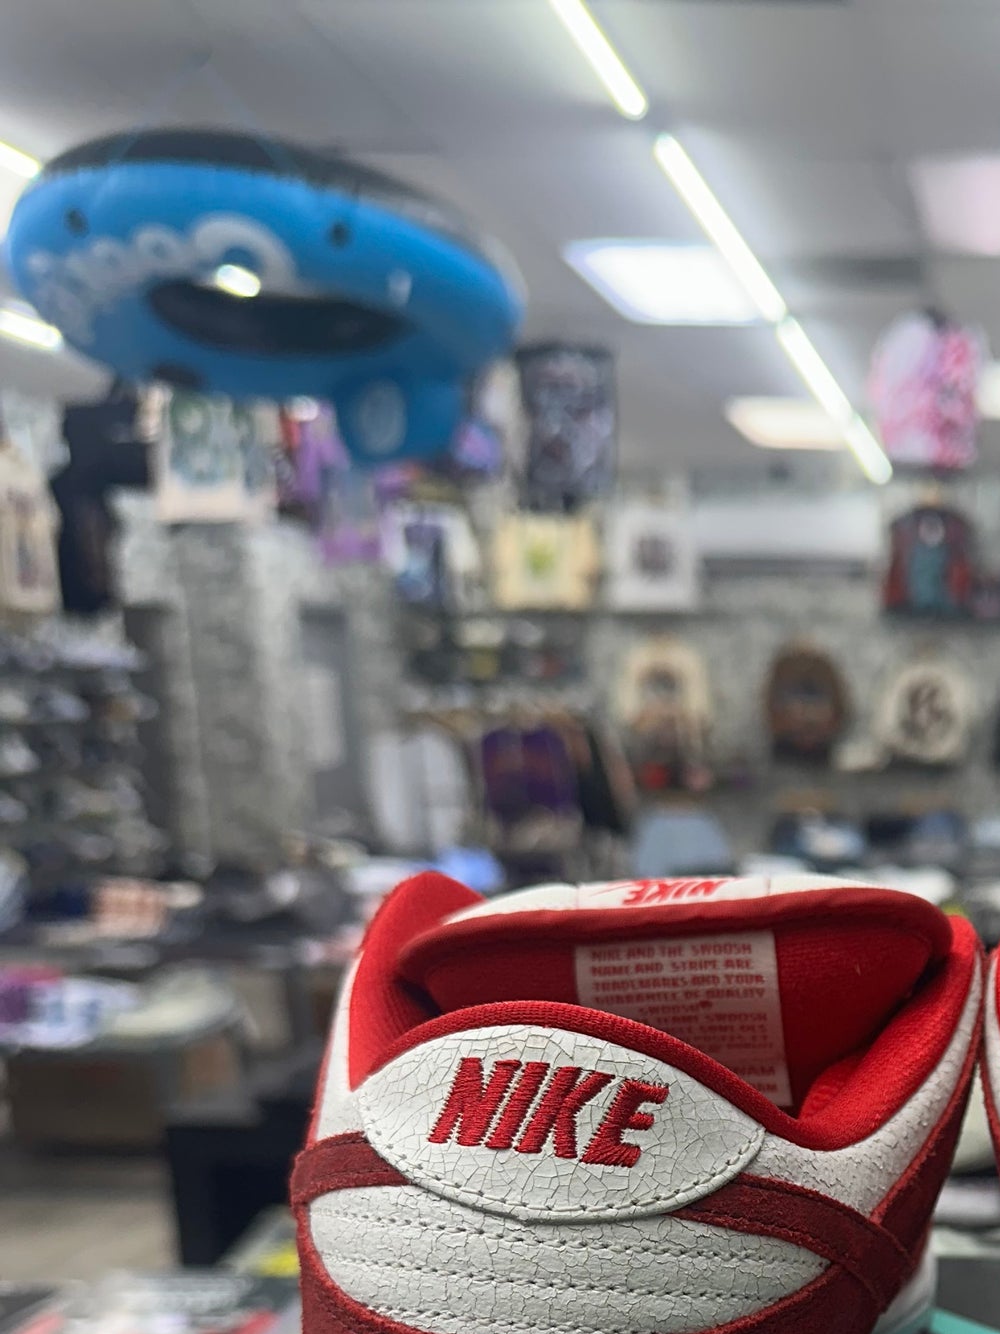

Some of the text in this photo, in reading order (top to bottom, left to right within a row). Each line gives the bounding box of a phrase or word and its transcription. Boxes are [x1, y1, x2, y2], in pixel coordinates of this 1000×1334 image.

[622, 879, 729, 905] NIKE
[626, 946, 655, 959] AND
[660, 944, 683, 957] THE
[690, 942, 753, 956] SWOOSH
[591, 964, 630, 977] NAME
[635, 961, 664, 974] AND
[670, 959, 718, 973] STRIPE
[427, 1057, 669, 1168] NIKE
